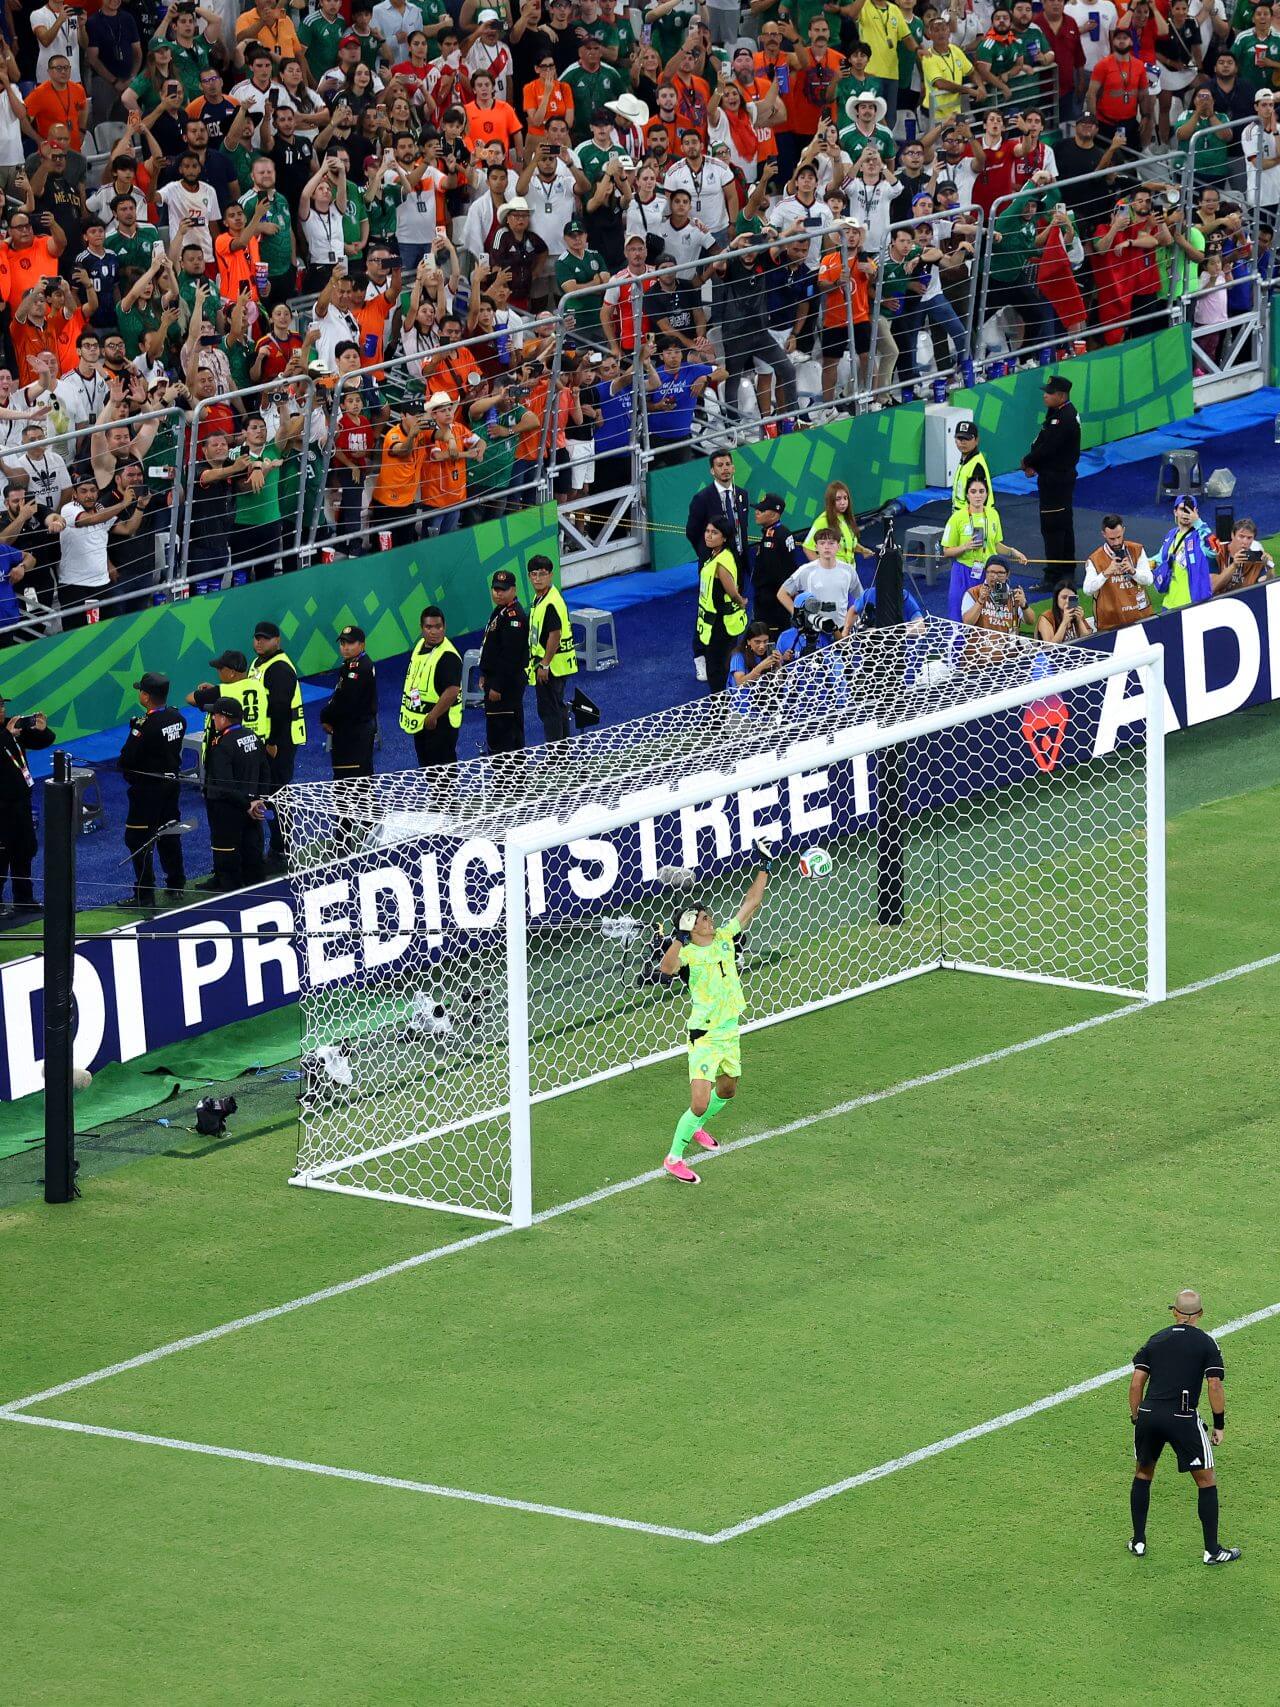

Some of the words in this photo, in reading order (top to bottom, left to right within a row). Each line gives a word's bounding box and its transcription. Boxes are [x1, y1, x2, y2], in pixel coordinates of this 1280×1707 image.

[162, 722, 184, 737] FUERZA
[167, 731, 181, 742] CIVIL
[237, 734, 258, 748] FUERZA
[244, 742, 258, 753] CIVIL
[177, 718, 878, 1027] PREDICTSTREET
[717, 960, 728, 978] 1
